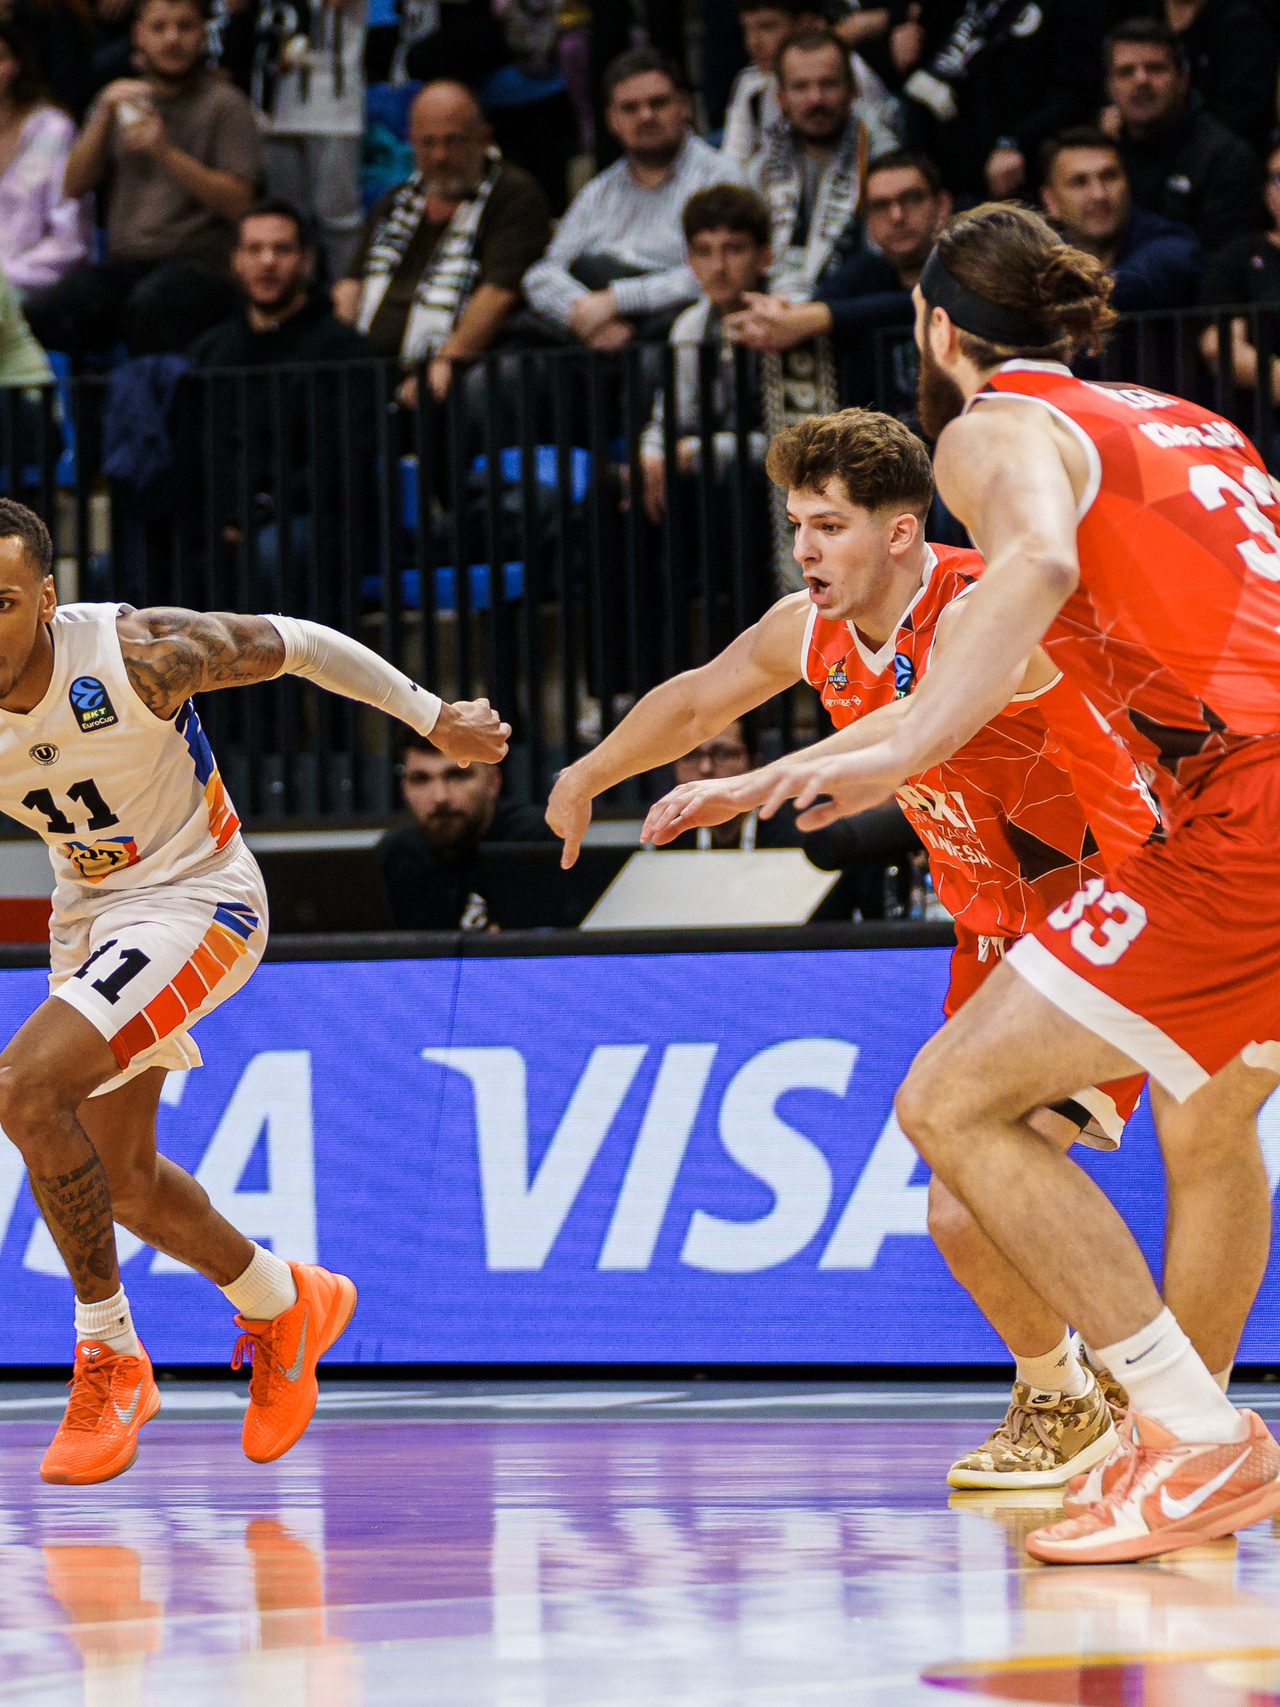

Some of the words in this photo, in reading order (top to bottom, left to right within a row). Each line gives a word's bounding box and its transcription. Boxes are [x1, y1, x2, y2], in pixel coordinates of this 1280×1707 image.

[81, 715, 115, 729] EuroCup
[21, 778, 120, 834] 11
[1047, 878, 1148, 967] 33
[73, 939, 152, 1005] 11
